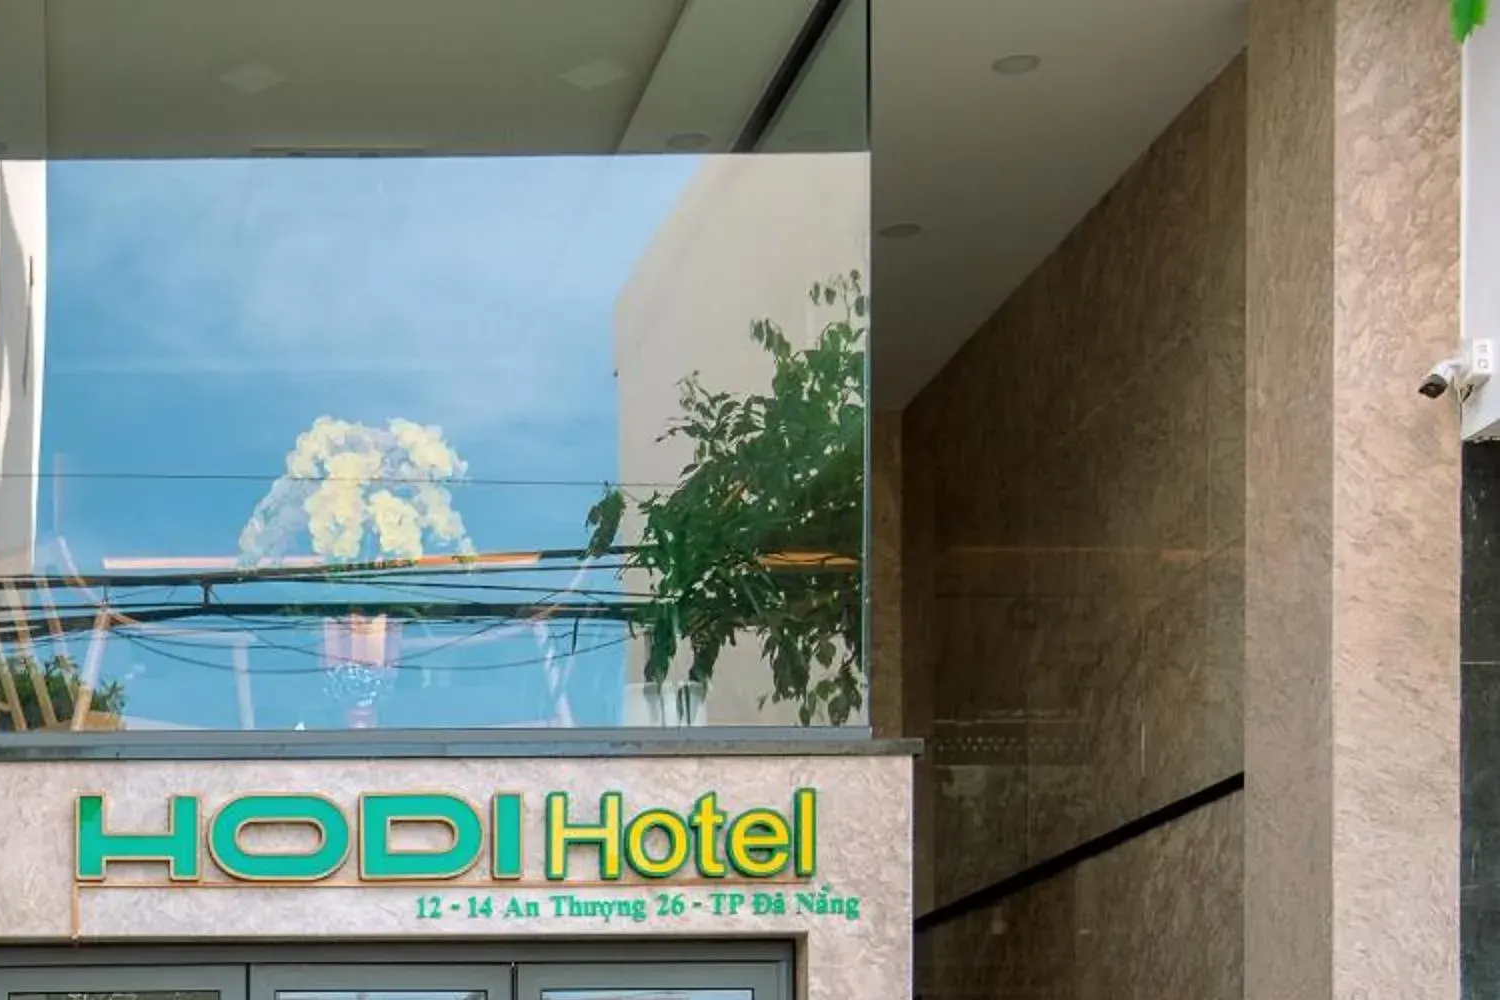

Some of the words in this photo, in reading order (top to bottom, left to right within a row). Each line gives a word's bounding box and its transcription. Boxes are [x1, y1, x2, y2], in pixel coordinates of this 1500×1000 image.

[75, 792, 524, 881] HODI
[546, 788, 818, 880] Hotel
[416, 895, 443, 919] 12
[467, 895, 493, 919] 14
[503, 896, 540, 919] An
[549, 894, 647, 922] Thượng
[656, 893, 685, 916] 26
[709, 892, 745, 915] TP
